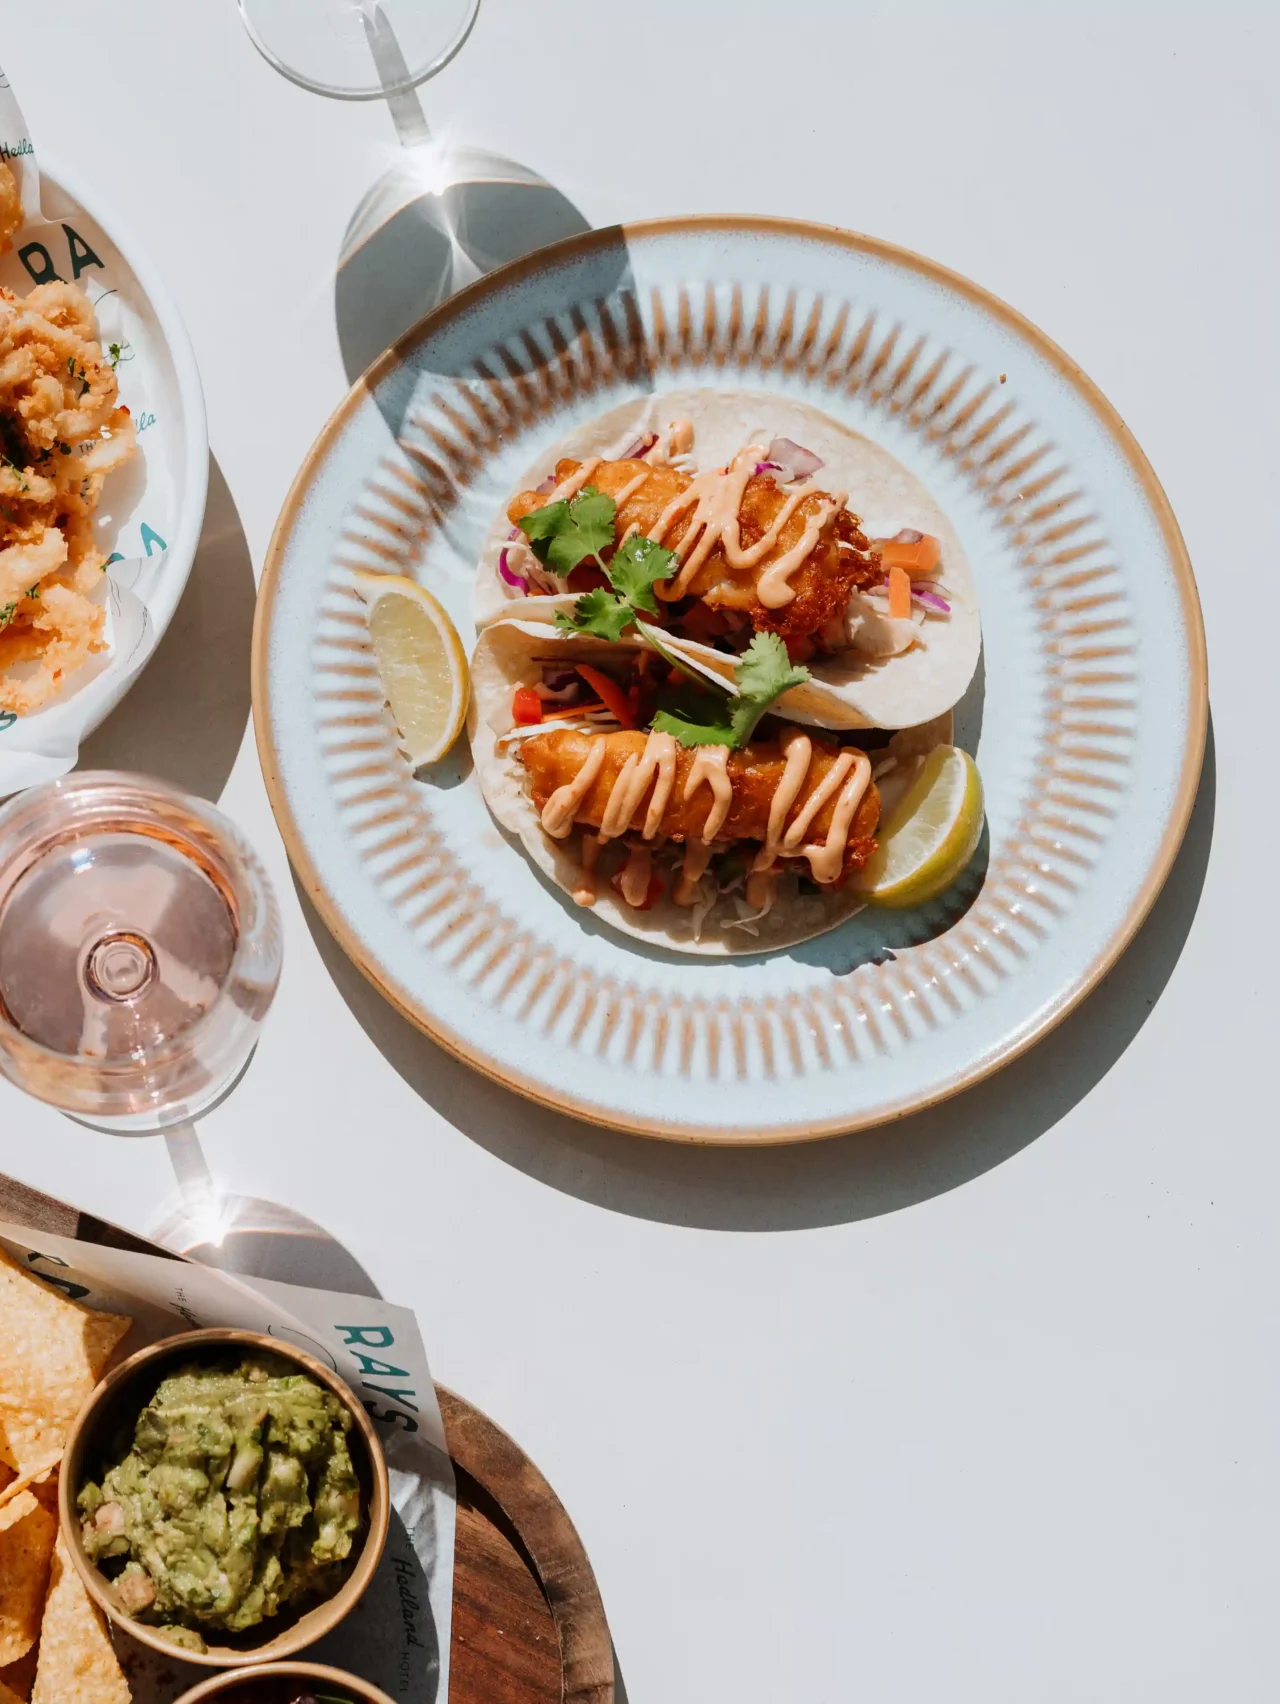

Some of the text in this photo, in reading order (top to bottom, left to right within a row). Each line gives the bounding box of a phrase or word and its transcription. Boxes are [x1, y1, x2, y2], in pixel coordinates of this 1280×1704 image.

[333, 1325, 419, 1432] RAYS
[391, 1557, 425, 1648] Hedland
[399, 1652, 411, 1692] HOTEL
